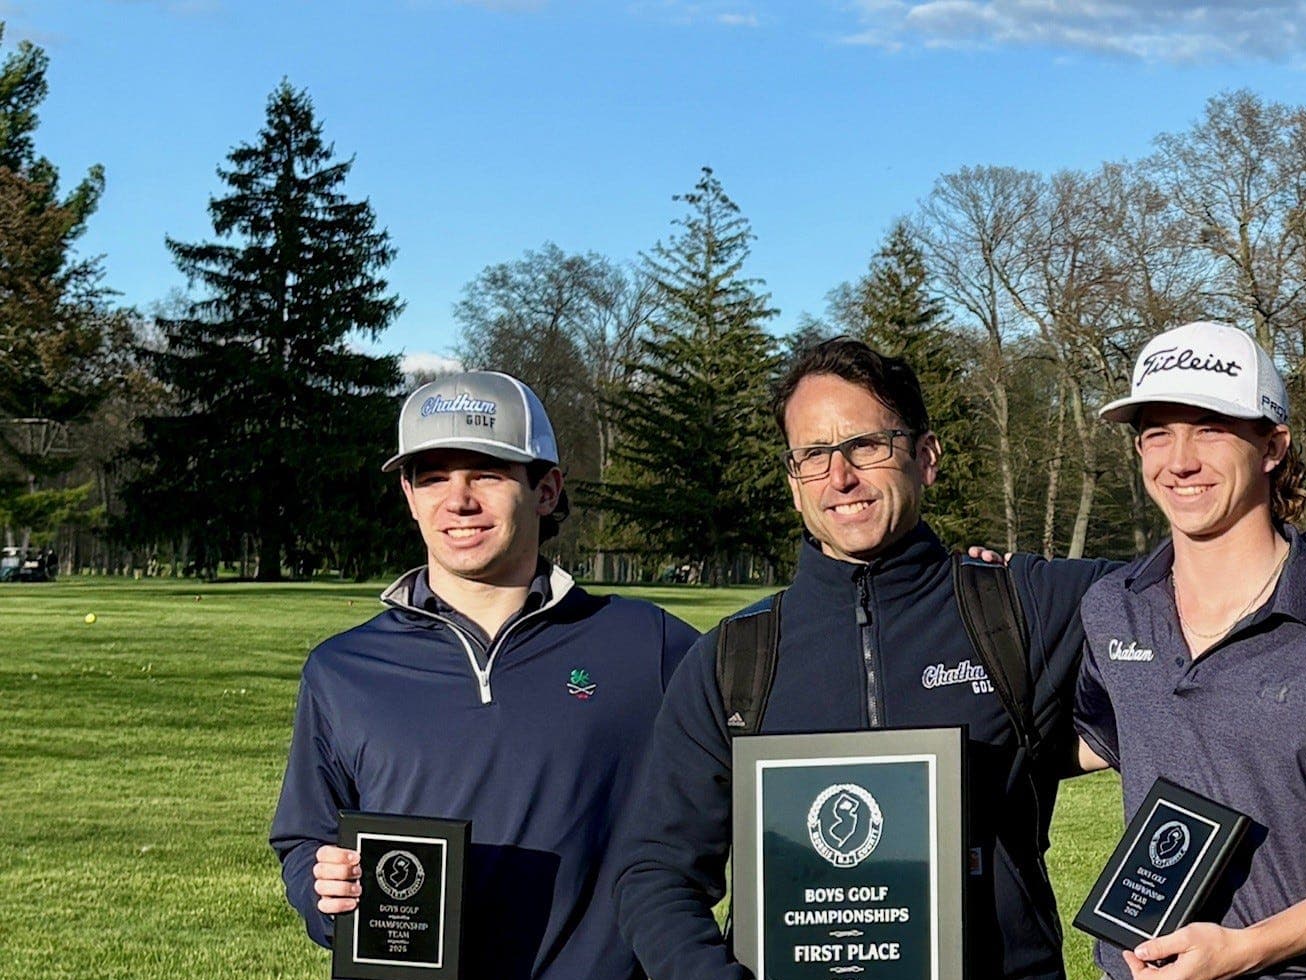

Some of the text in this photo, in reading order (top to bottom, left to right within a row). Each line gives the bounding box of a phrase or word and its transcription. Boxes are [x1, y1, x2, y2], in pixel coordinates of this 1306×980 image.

[1136, 346, 1242, 387] Titleist
[421, 393, 496, 417] Chatham
[466, 414, 496, 429] GOLF
[922, 660, 988, 689] Chatha
[971, 679, 995, 694] GOL
[805, 887, 889, 903] BOYS GOLF
[380, 904, 419, 914] BOYS GOLF
[784, 908, 909, 925] CHAMPIONSHIPS
[369, 919, 428, 931] CHAMPIONSHIP
[388, 931, 410, 939] TEAM
[794, 943, 900, 962] FIRST PLACE
